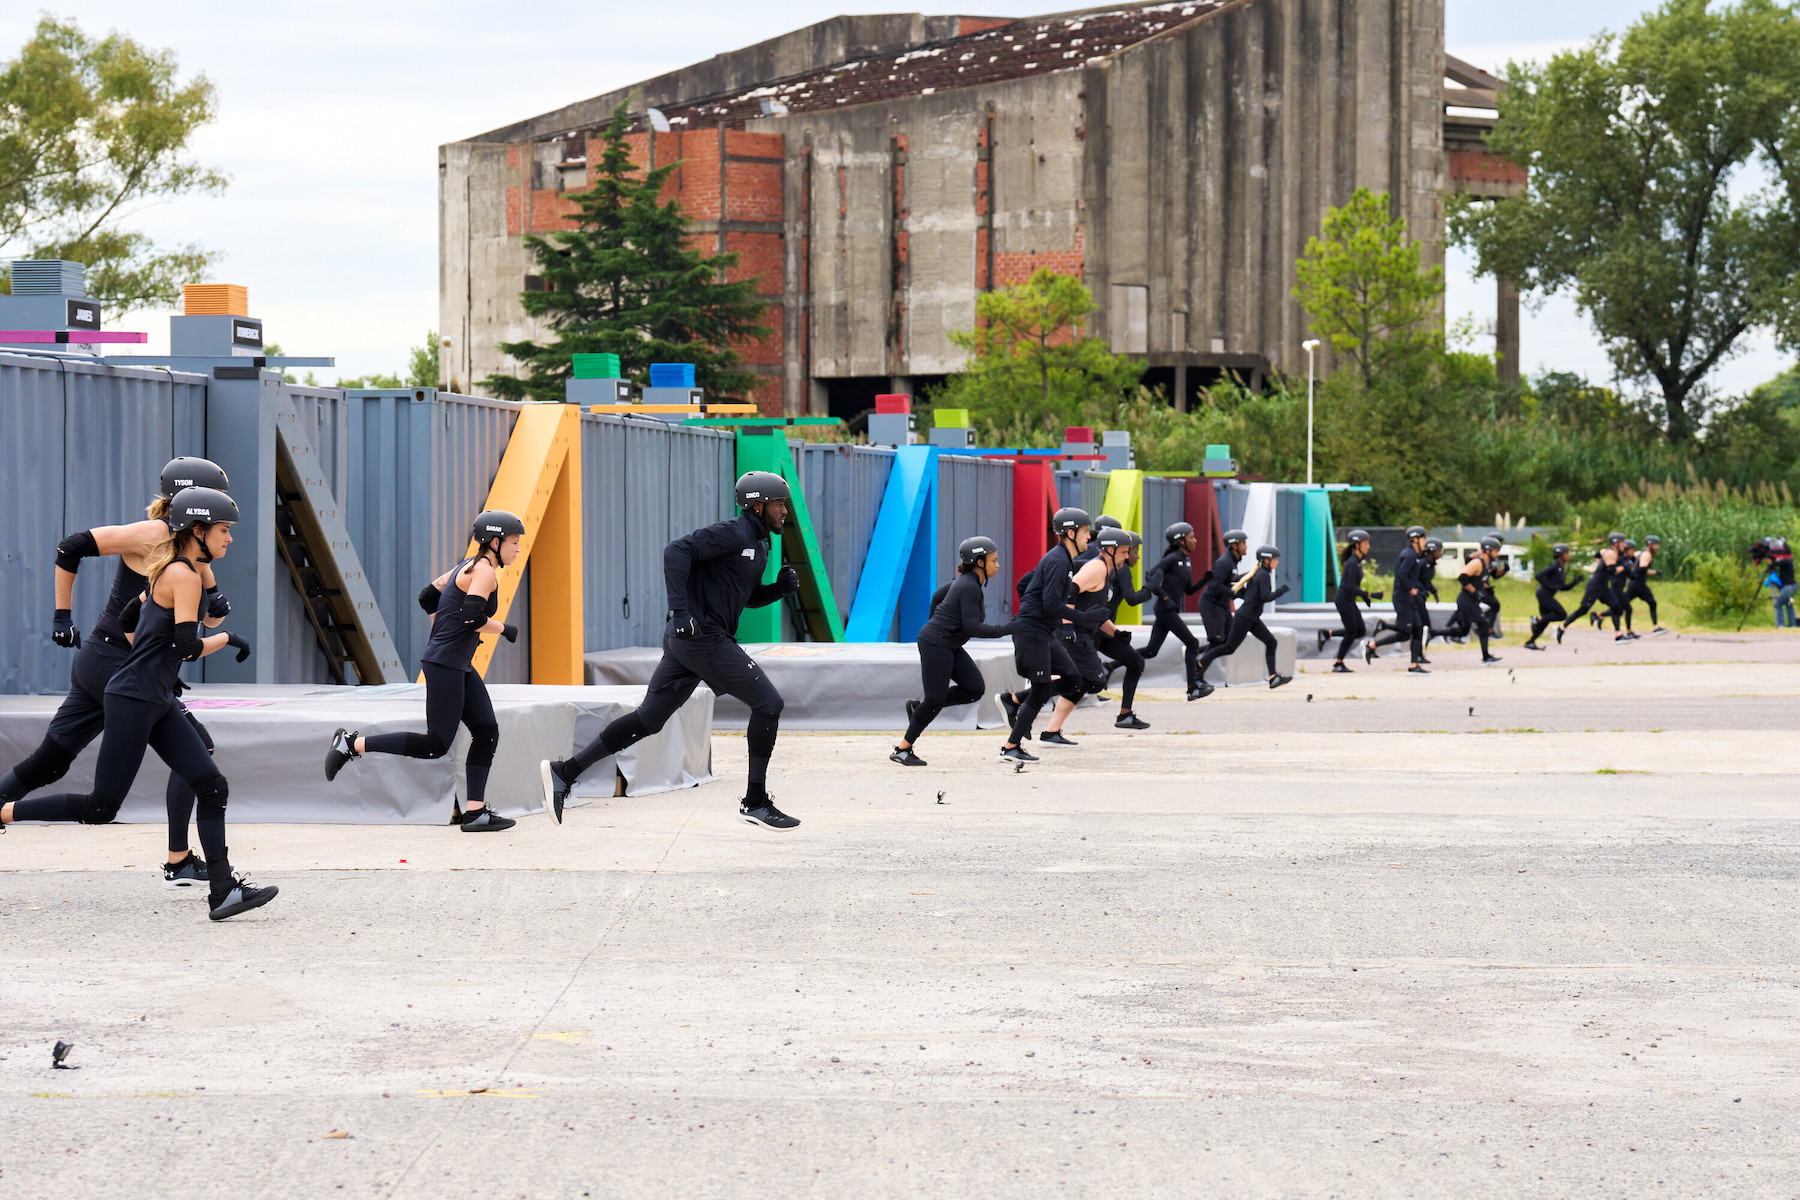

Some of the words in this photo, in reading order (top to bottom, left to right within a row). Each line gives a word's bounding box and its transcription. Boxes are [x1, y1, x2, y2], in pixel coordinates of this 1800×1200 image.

[76, 308, 93, 322] JAMES
[174, 479, 194, 487] TYSON
[185, 508, 211, 516] ALYSSA
